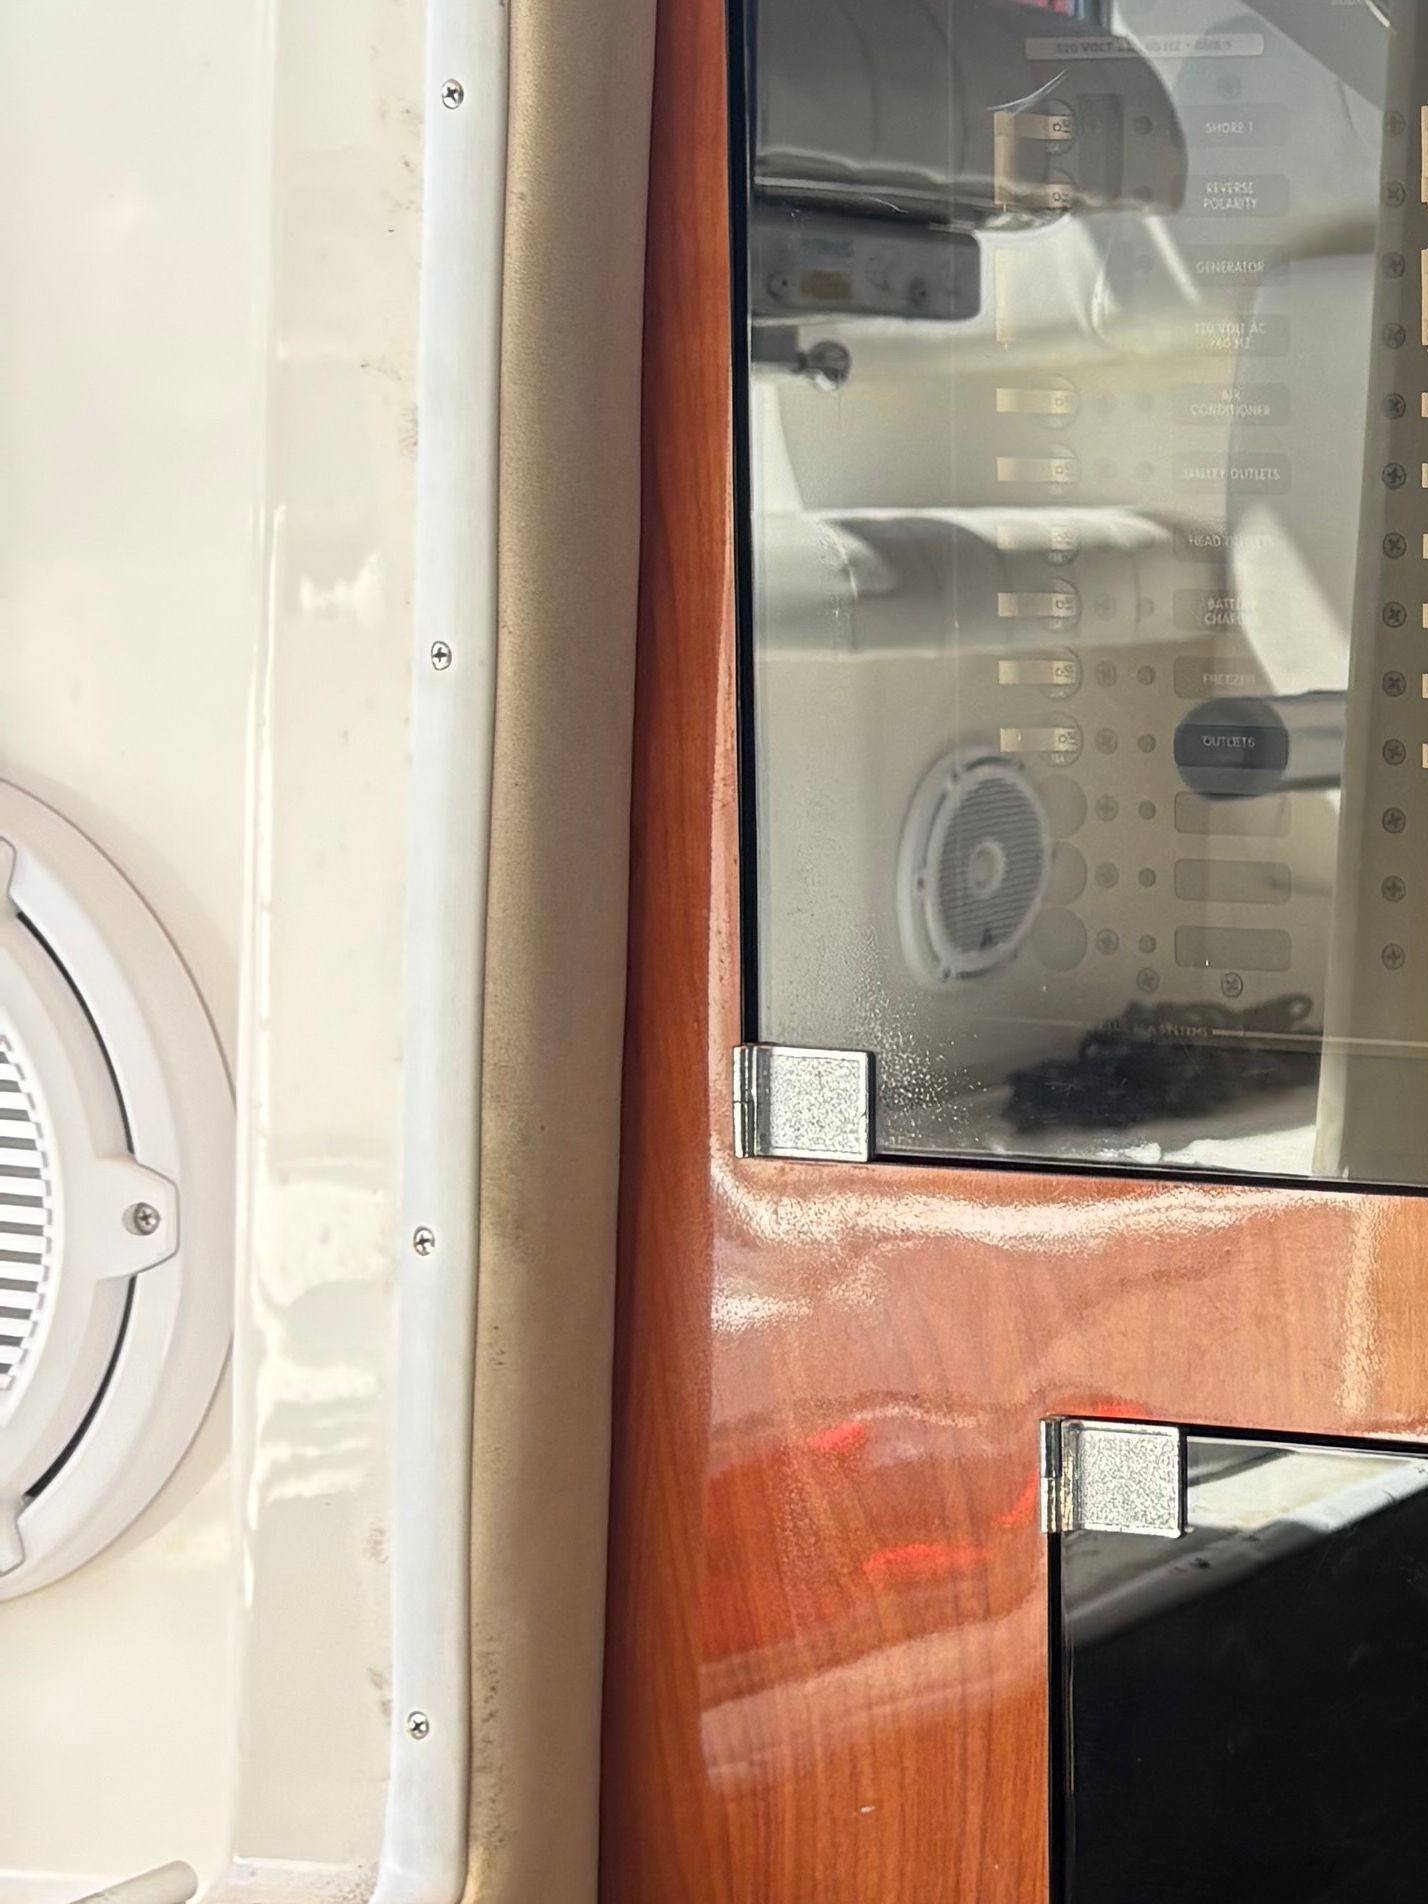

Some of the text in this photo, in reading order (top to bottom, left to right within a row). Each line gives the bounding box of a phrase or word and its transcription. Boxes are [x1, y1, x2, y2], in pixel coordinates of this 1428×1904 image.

[1204, 121, 1244, 134] SHORE
[1206, 182, 1255, 195] REVERSE
[1203, 197, 1257, 210] POLARITY
[1195, 260, 1266, 274] GENERATOR
[1249, 321, 1266, 335] AC
[1191, 403, 1271, 417] CONDITIONER
[1230, 467, 1281, 481] OUTLETS
[1188, 534, 1222, 547] HEAD
[1202, 736, 1256, 748] OUTLETS
